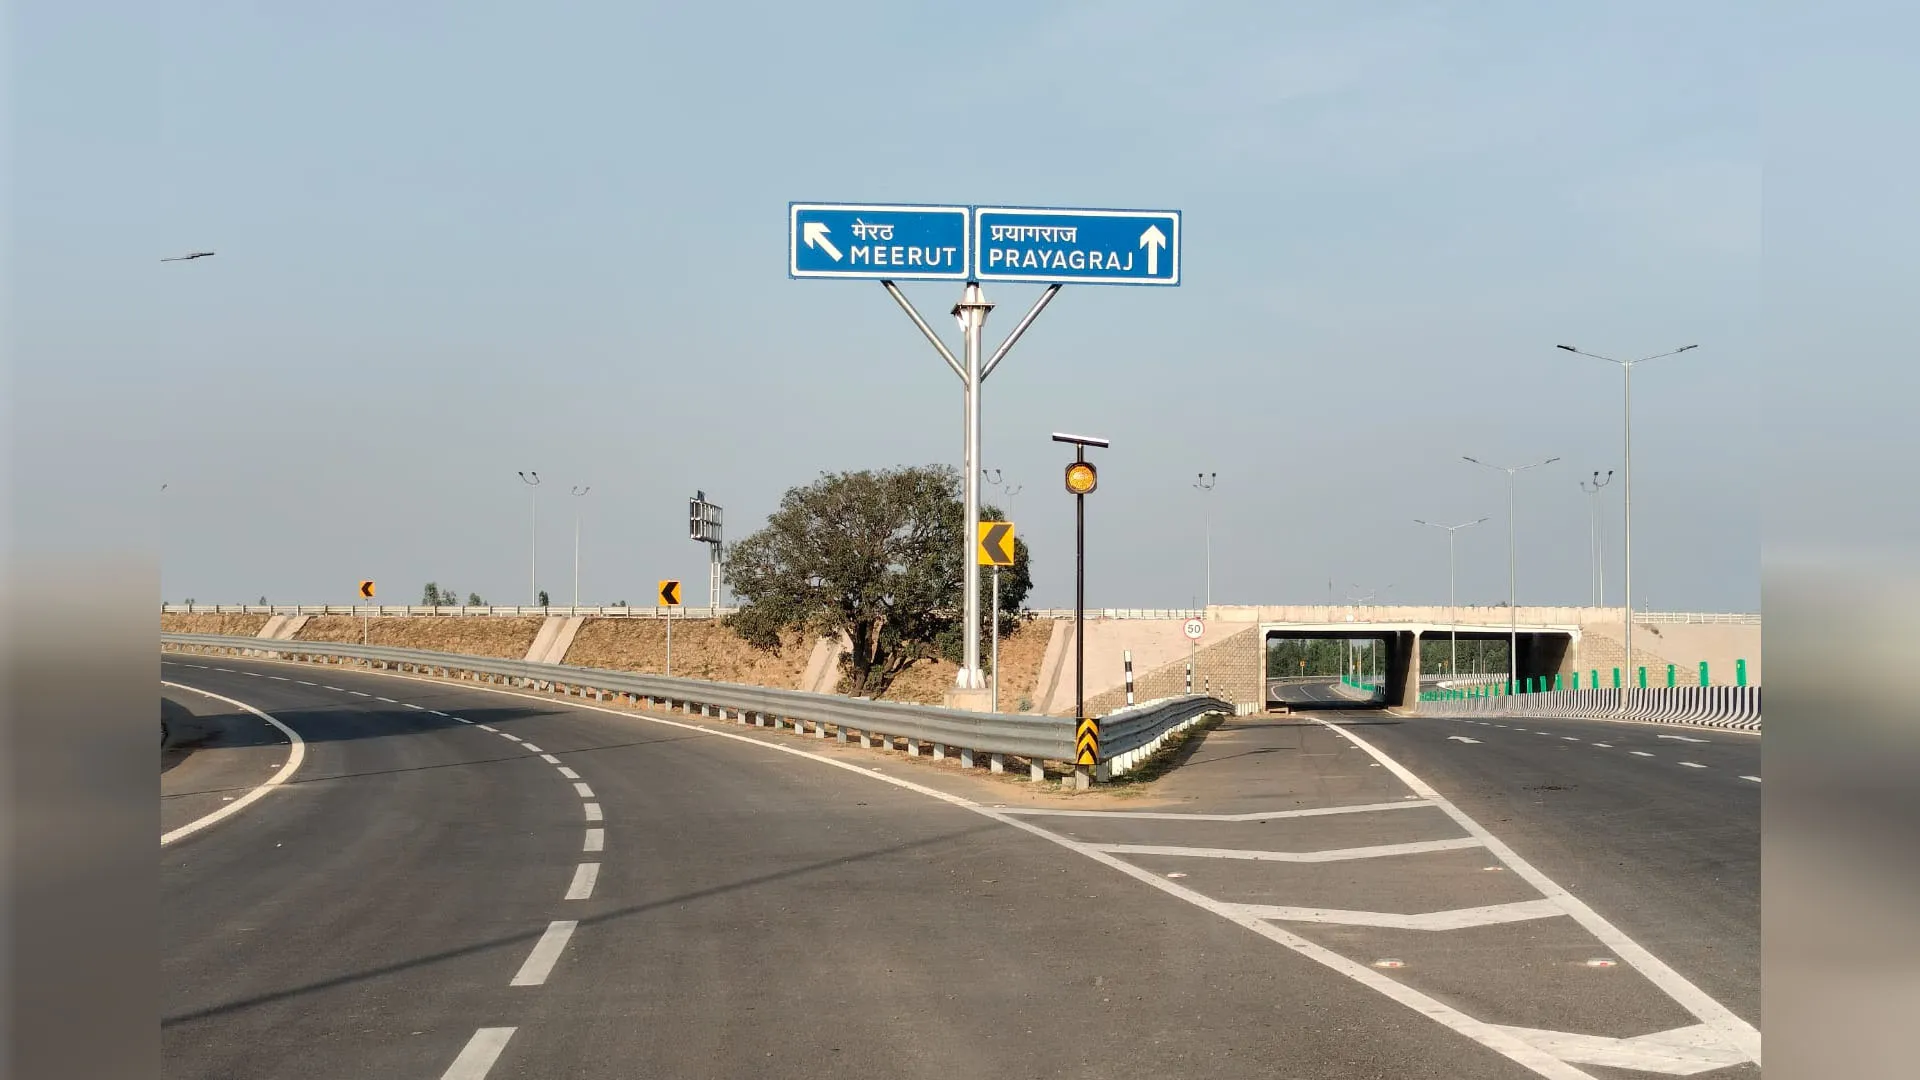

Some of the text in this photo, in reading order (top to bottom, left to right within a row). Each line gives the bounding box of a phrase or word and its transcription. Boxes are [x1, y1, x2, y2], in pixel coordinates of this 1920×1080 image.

[851, 218, 895, 241] मेरठ
[990, 225, 1078, 243] प्रयागराज
[851, 246, 957, 266] MEERUT
[989, 248, 1133, 271] PRAYAGRAJ
[1187, 624, 1201, 634] 50
